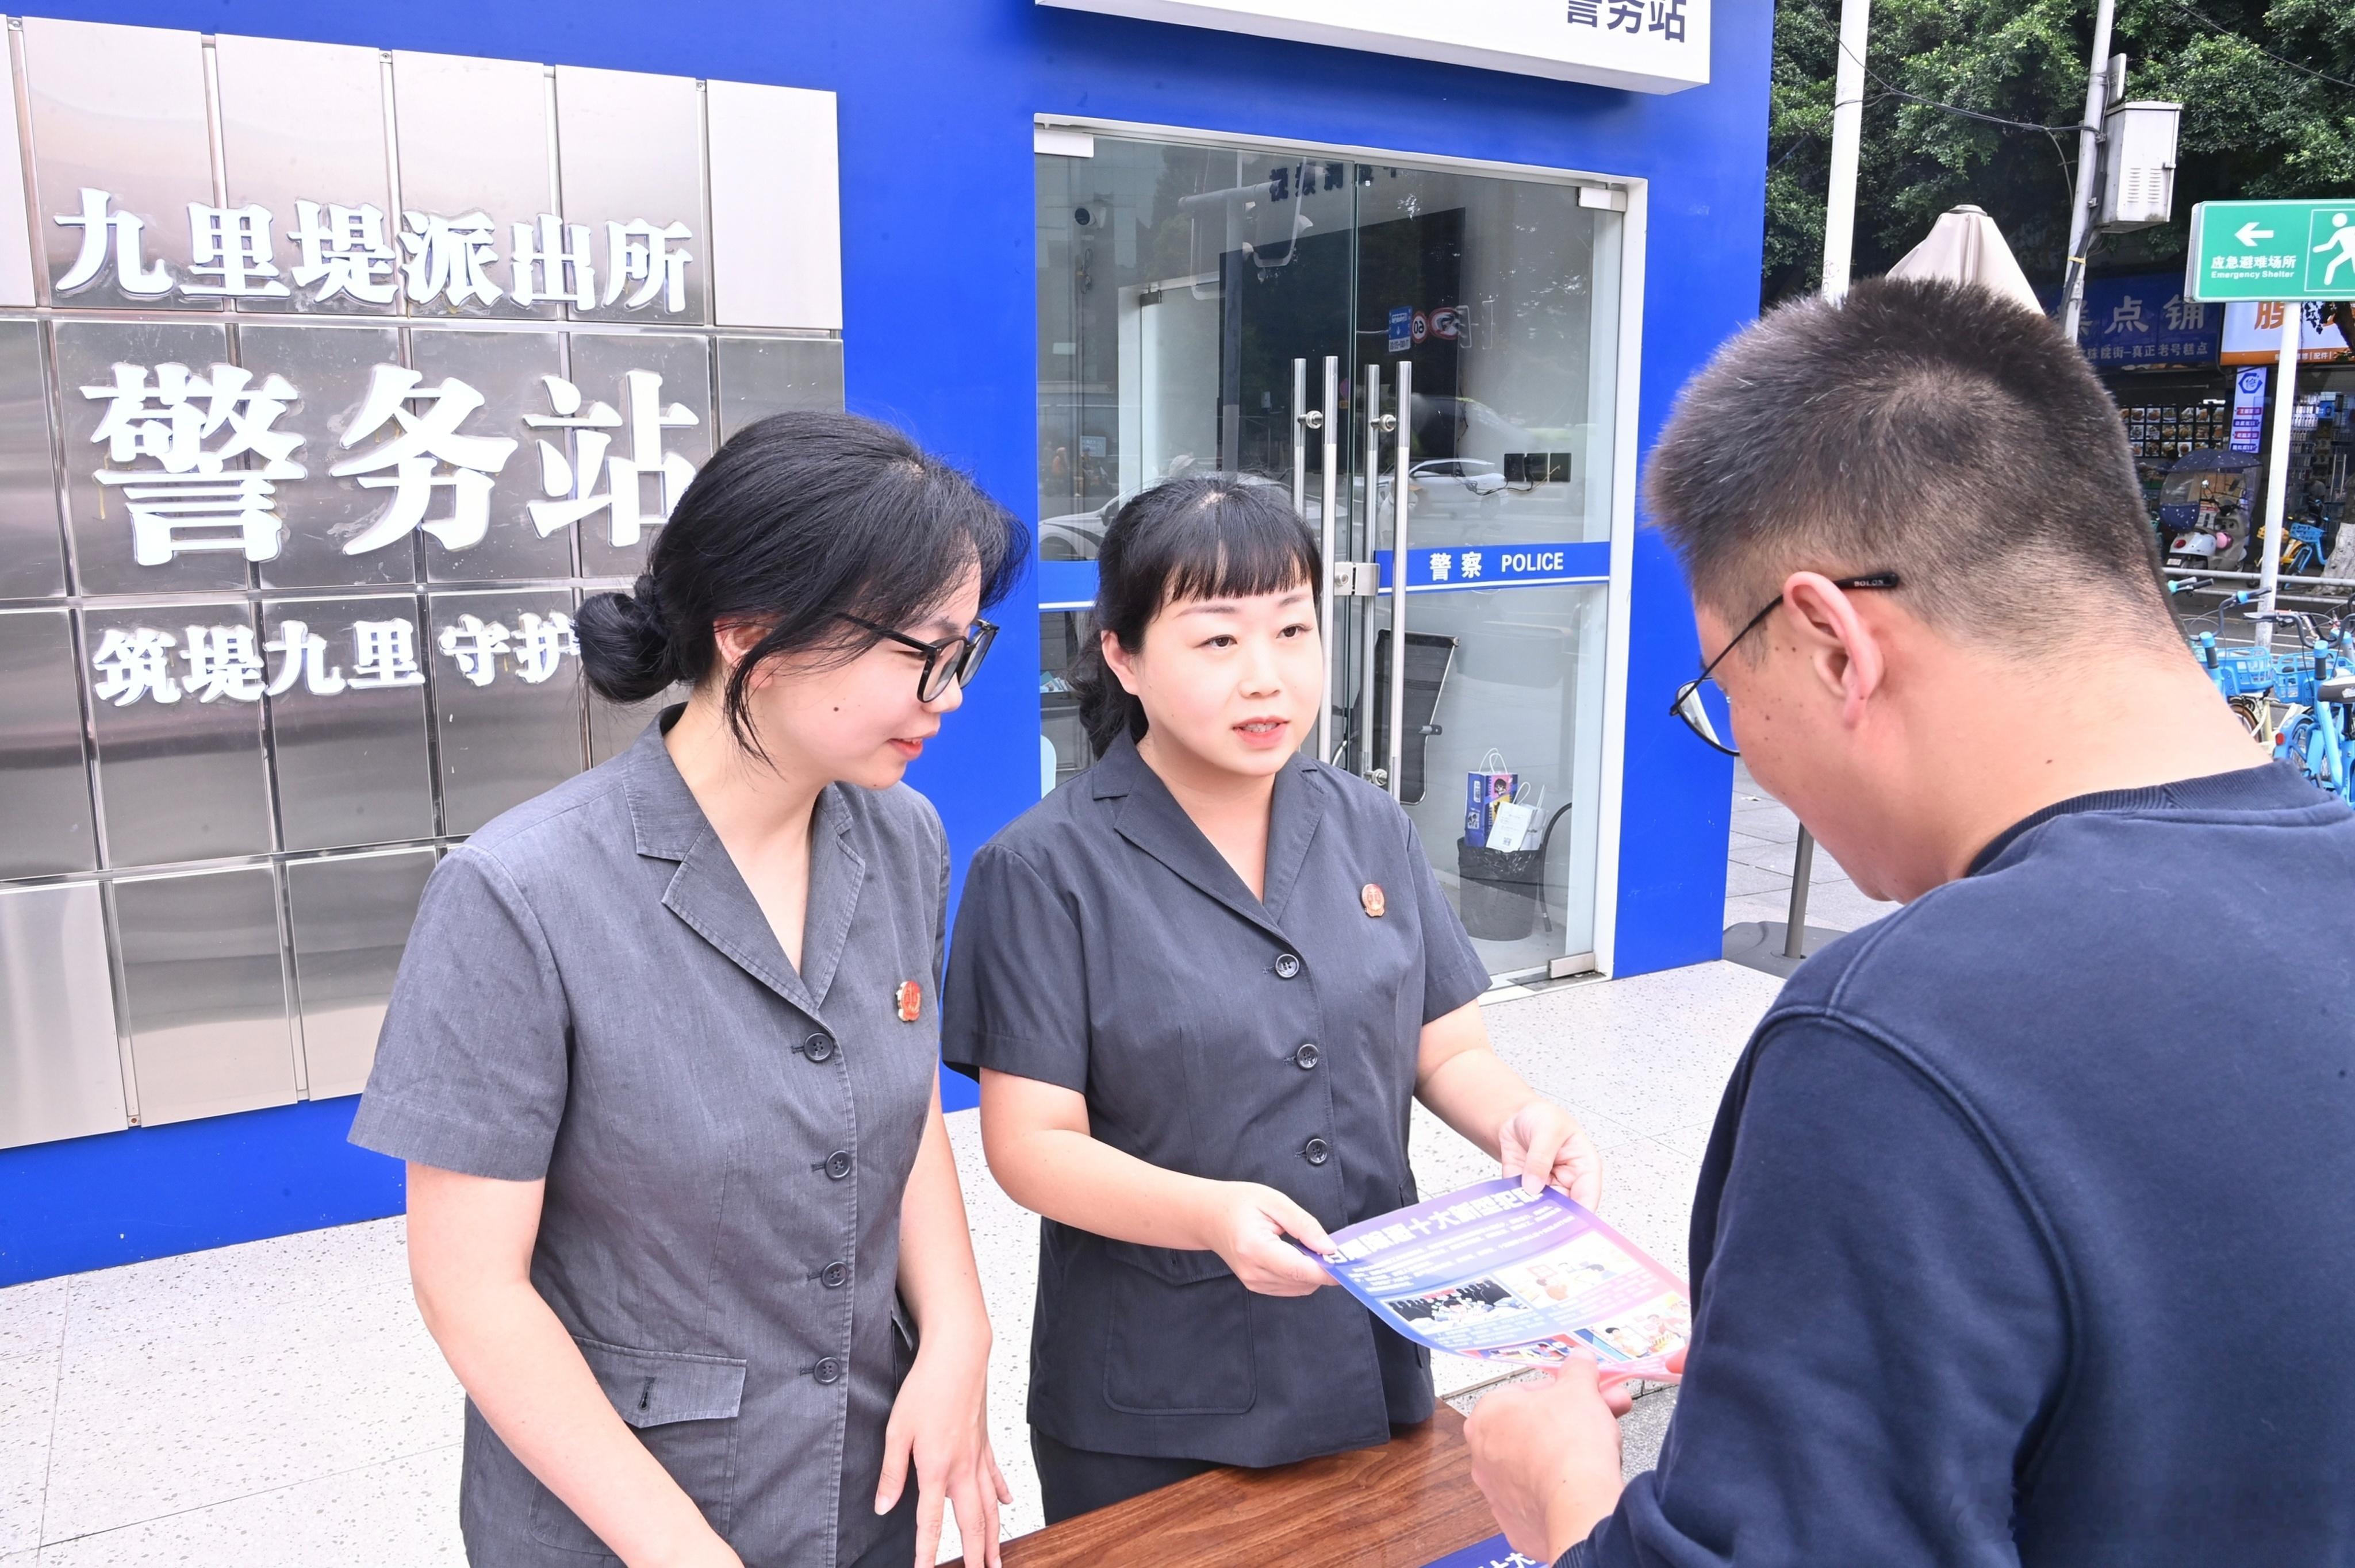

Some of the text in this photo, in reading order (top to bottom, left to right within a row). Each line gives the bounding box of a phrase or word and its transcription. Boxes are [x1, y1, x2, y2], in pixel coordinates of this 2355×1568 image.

[54, 187, 692, 313] 九里堤派出所
[2211, 255, 2296, 269] 应急避难场所
[2211, 271, 2260, 279] Emergency
[80, 362, 700, 566] 警务站
[1429, 551, 1564, 581] 警察 POLICE
[93, 617, 426, 707] 筑堤九里
